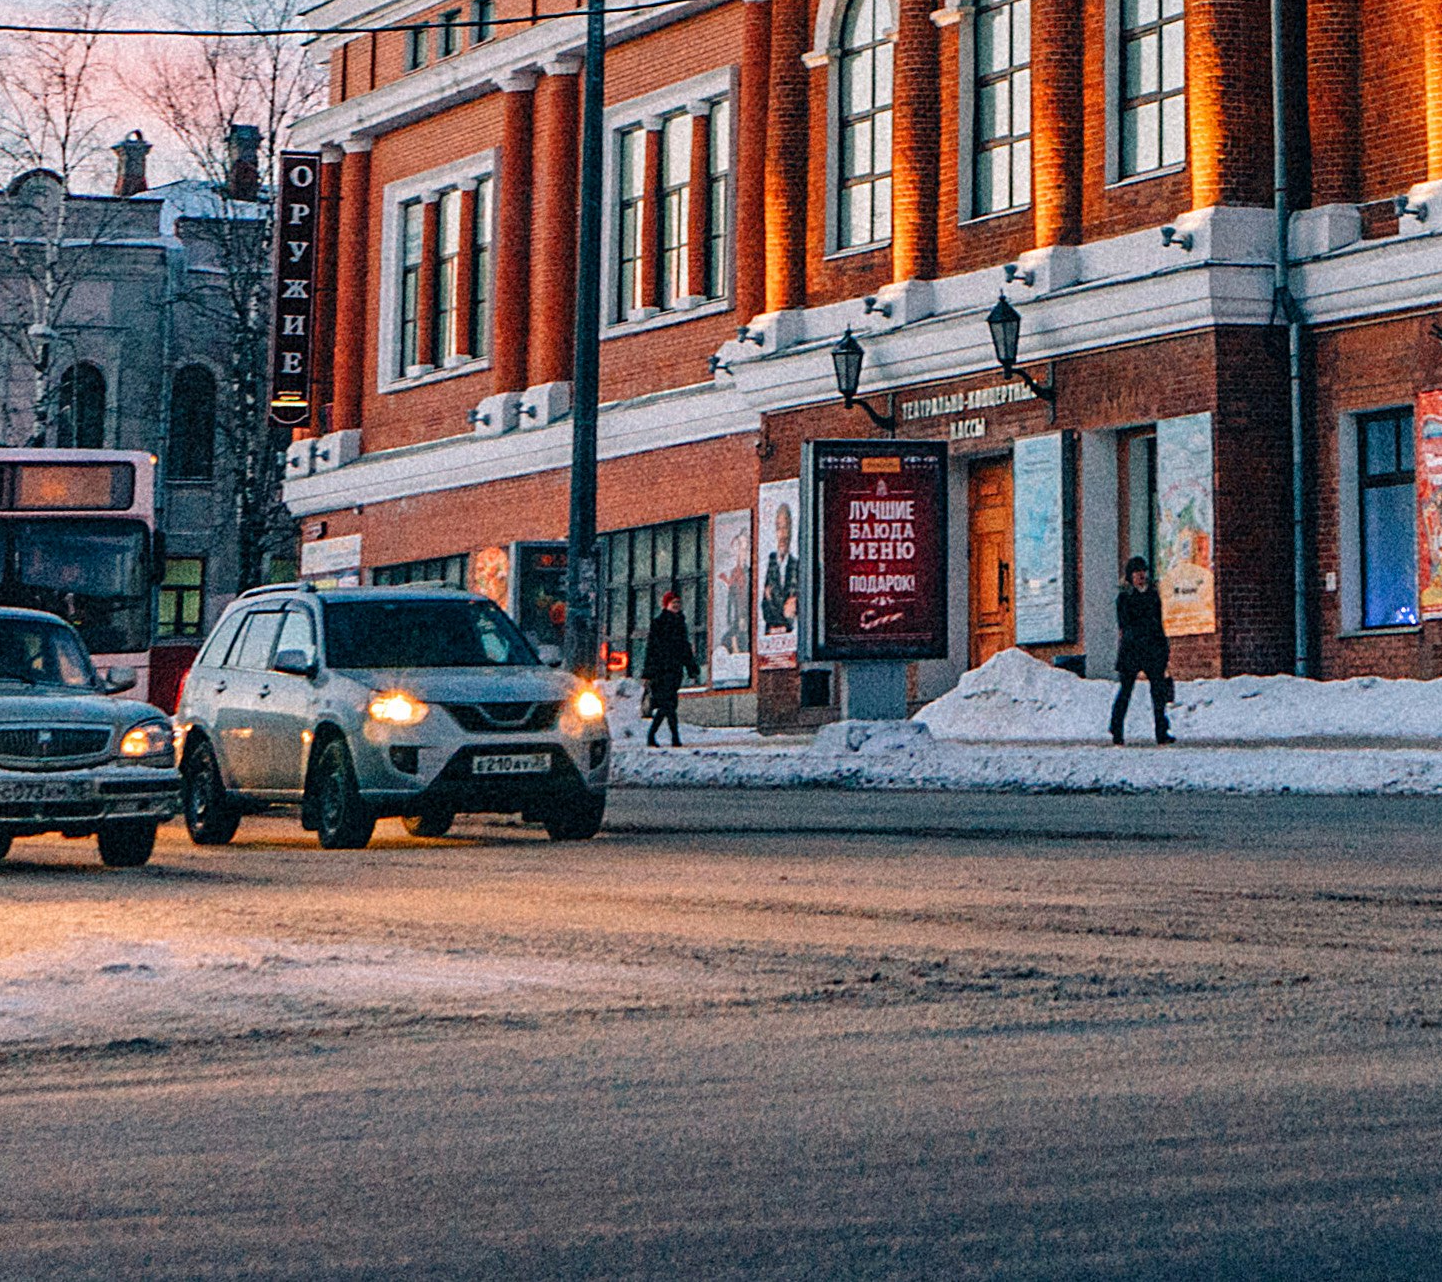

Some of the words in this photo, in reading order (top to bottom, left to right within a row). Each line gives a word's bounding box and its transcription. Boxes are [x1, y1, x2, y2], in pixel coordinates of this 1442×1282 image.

[280, 165, 314, 374] ОРУЖИЕ
[950, 416, 986, 441] КАССЫ
[848, 500, 916, 521] ЛУЧШИЕ
[848, 522, 916, 541] БЛЮДА
[848, 541, 916, 561] МЕНЮ
[848, 575, 916, 594] ПОДАРОК!
